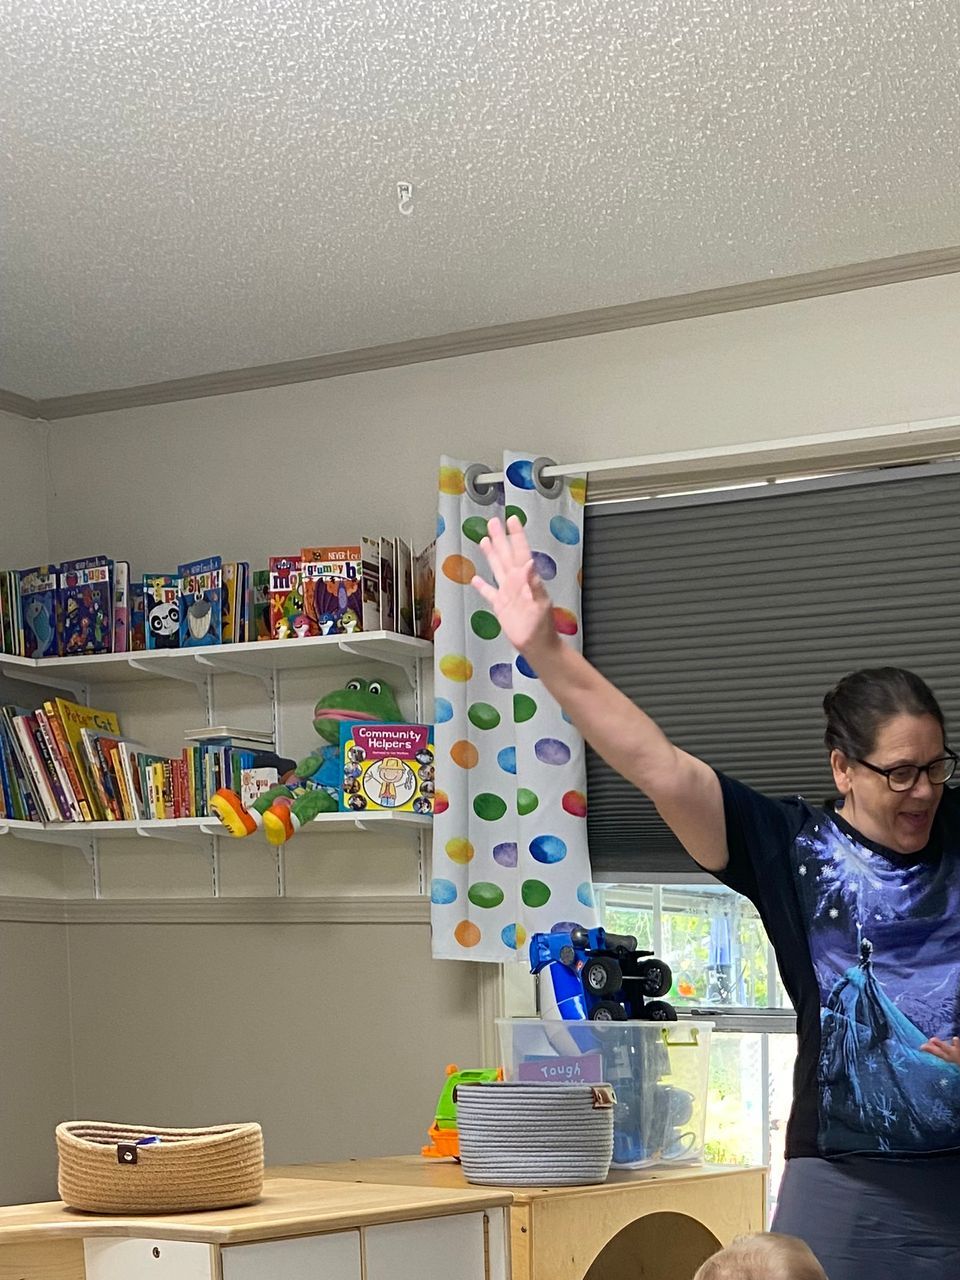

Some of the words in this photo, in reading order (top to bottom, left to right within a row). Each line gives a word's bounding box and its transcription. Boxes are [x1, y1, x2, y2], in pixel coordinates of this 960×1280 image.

[307, 564, 344, 576] grumpy
[359, 728, 421, 742] Community
[368, 738, 412, 750] Helpers
[540, 1062, 581, 1078] Tough
